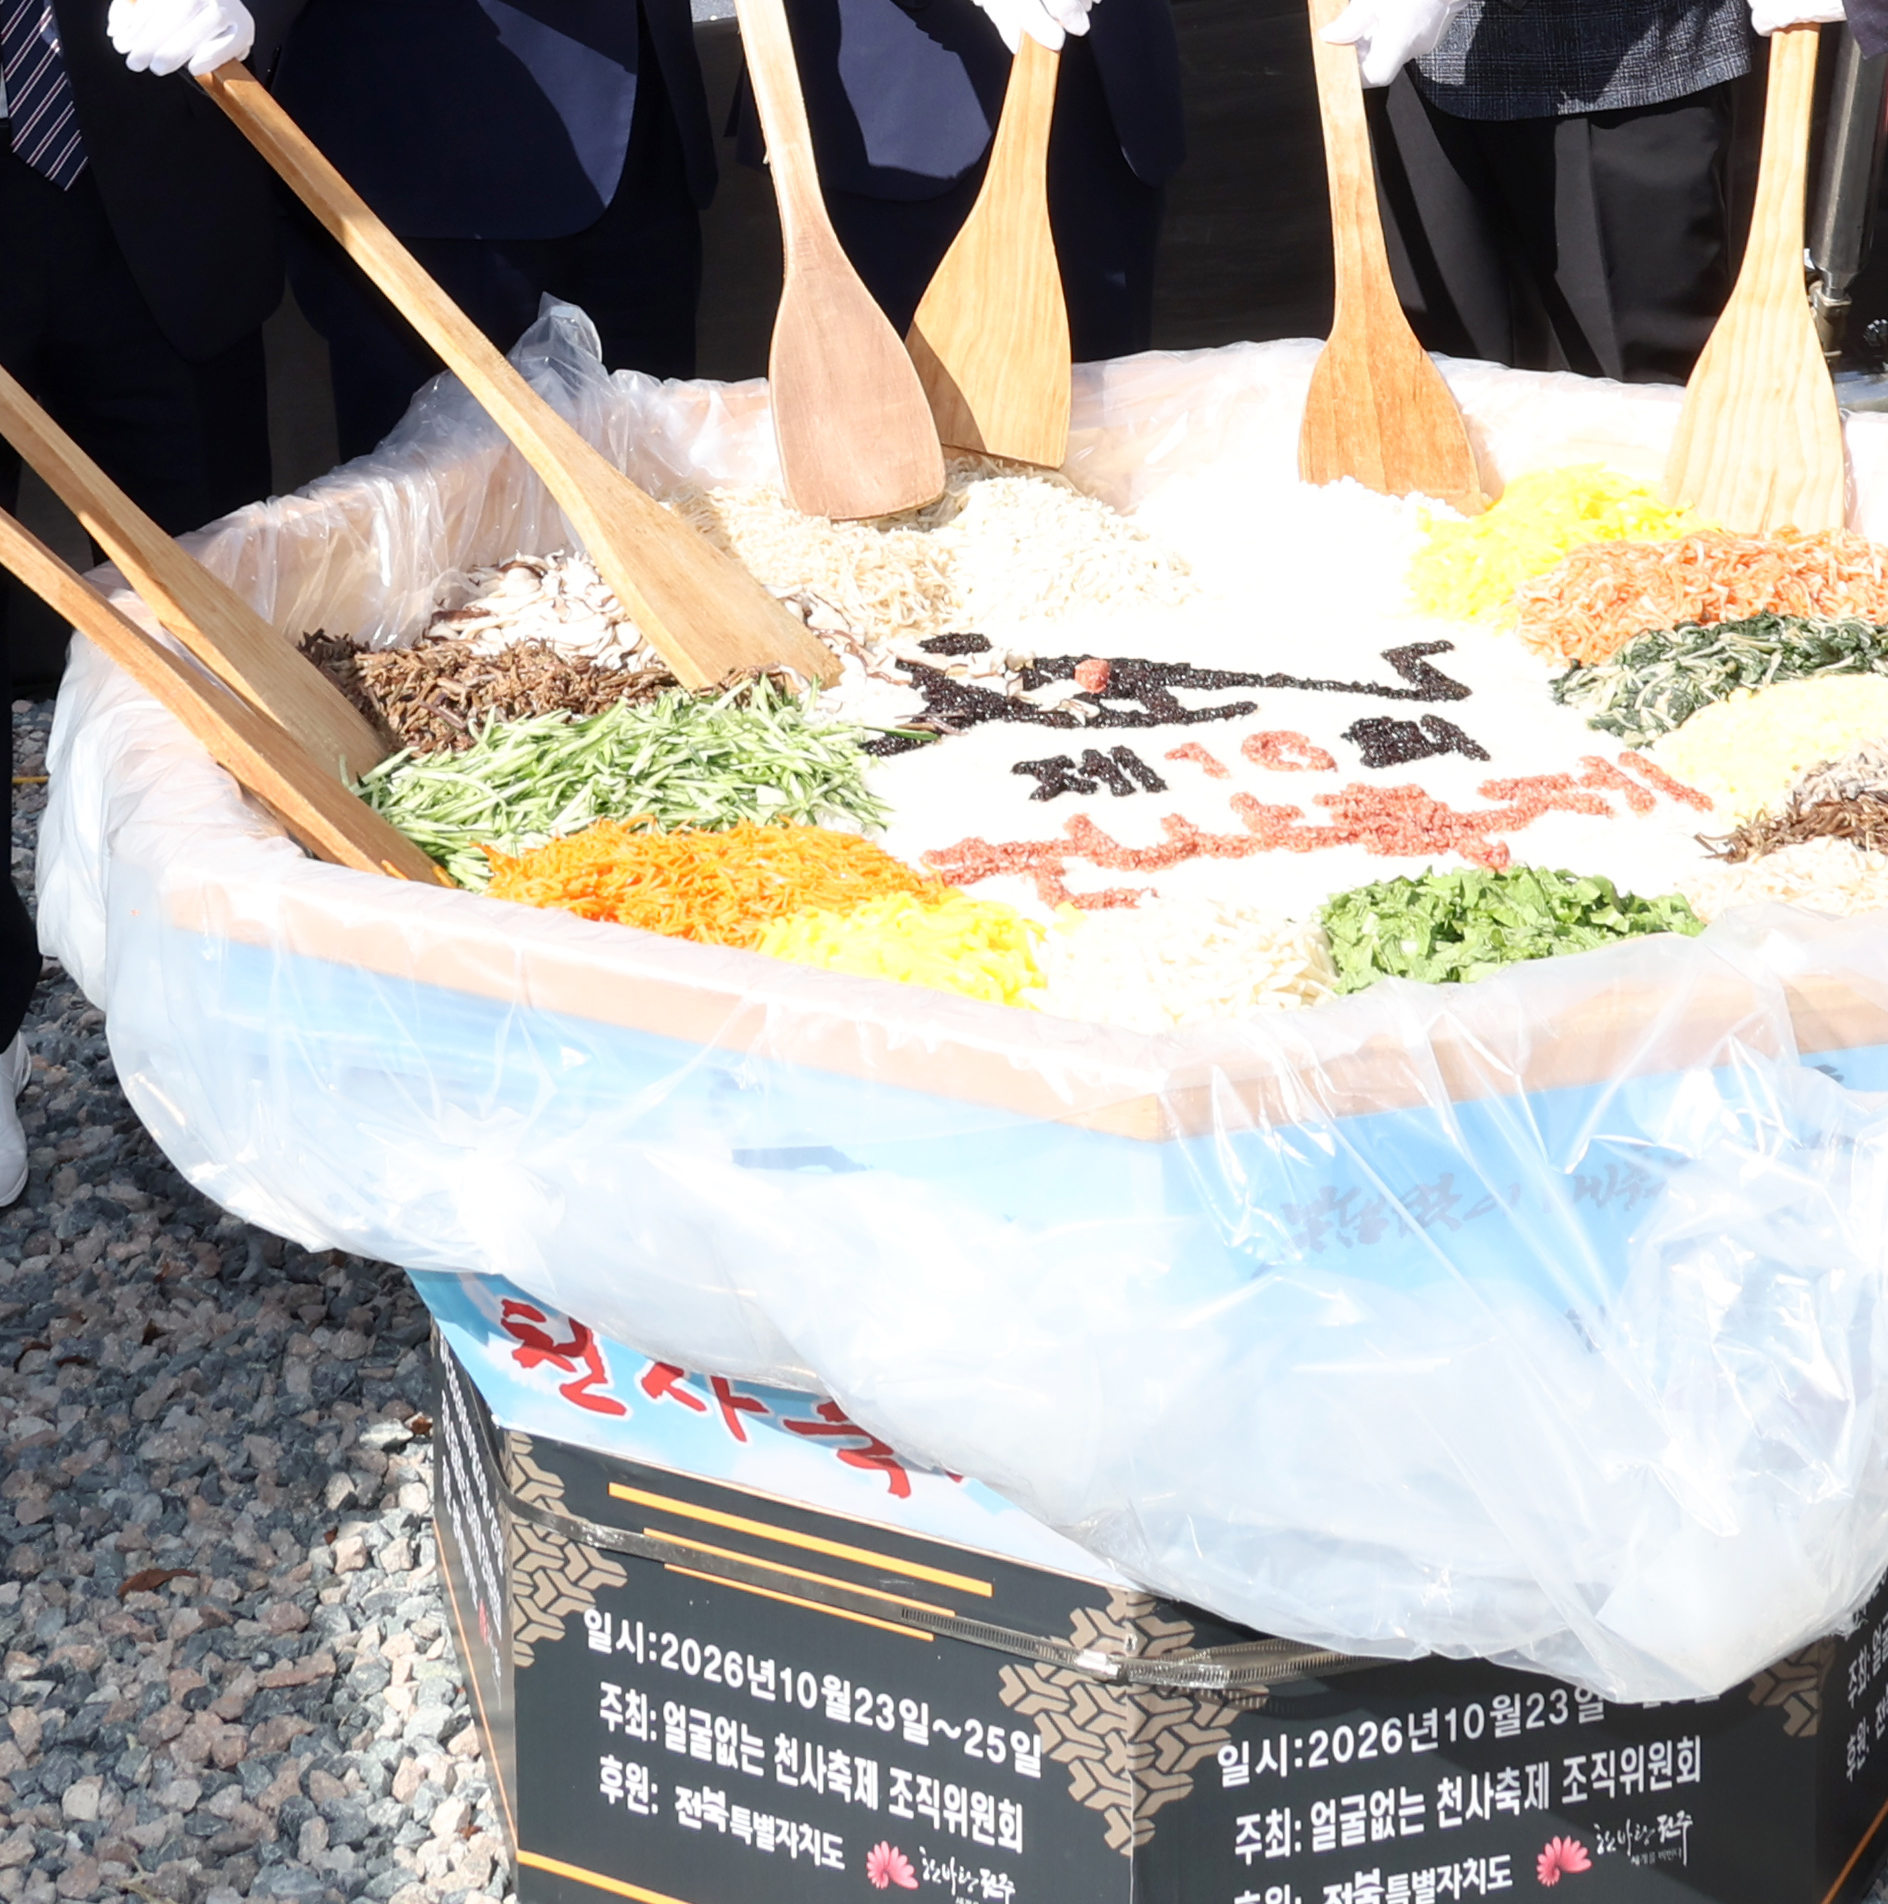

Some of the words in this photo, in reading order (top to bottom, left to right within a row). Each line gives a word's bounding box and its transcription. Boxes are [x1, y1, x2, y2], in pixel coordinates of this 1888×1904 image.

[599, 1681, 657, 1742] 주최:
[662, 1699, 764, 1777] 얼굴없는
[774, 1732, 878, 1812] 천사축제
[888, 1766, 1023, 1854] 조직위원회
[1217, 1684, 1720, 1789] 일시:2026년10월23일
[599, 1754, 659, 1815] 후원:
[674, 1785, 845, 1871] 전북특별자치도
[1234, 1807, 1302, 1867] 주최:
[1311, 1785, 1425, 1854] 얼굴없는
[1437, 1760, 1550, 1827] 천사축제
[1562, 1735, 1702, 1805] 조직위원회
